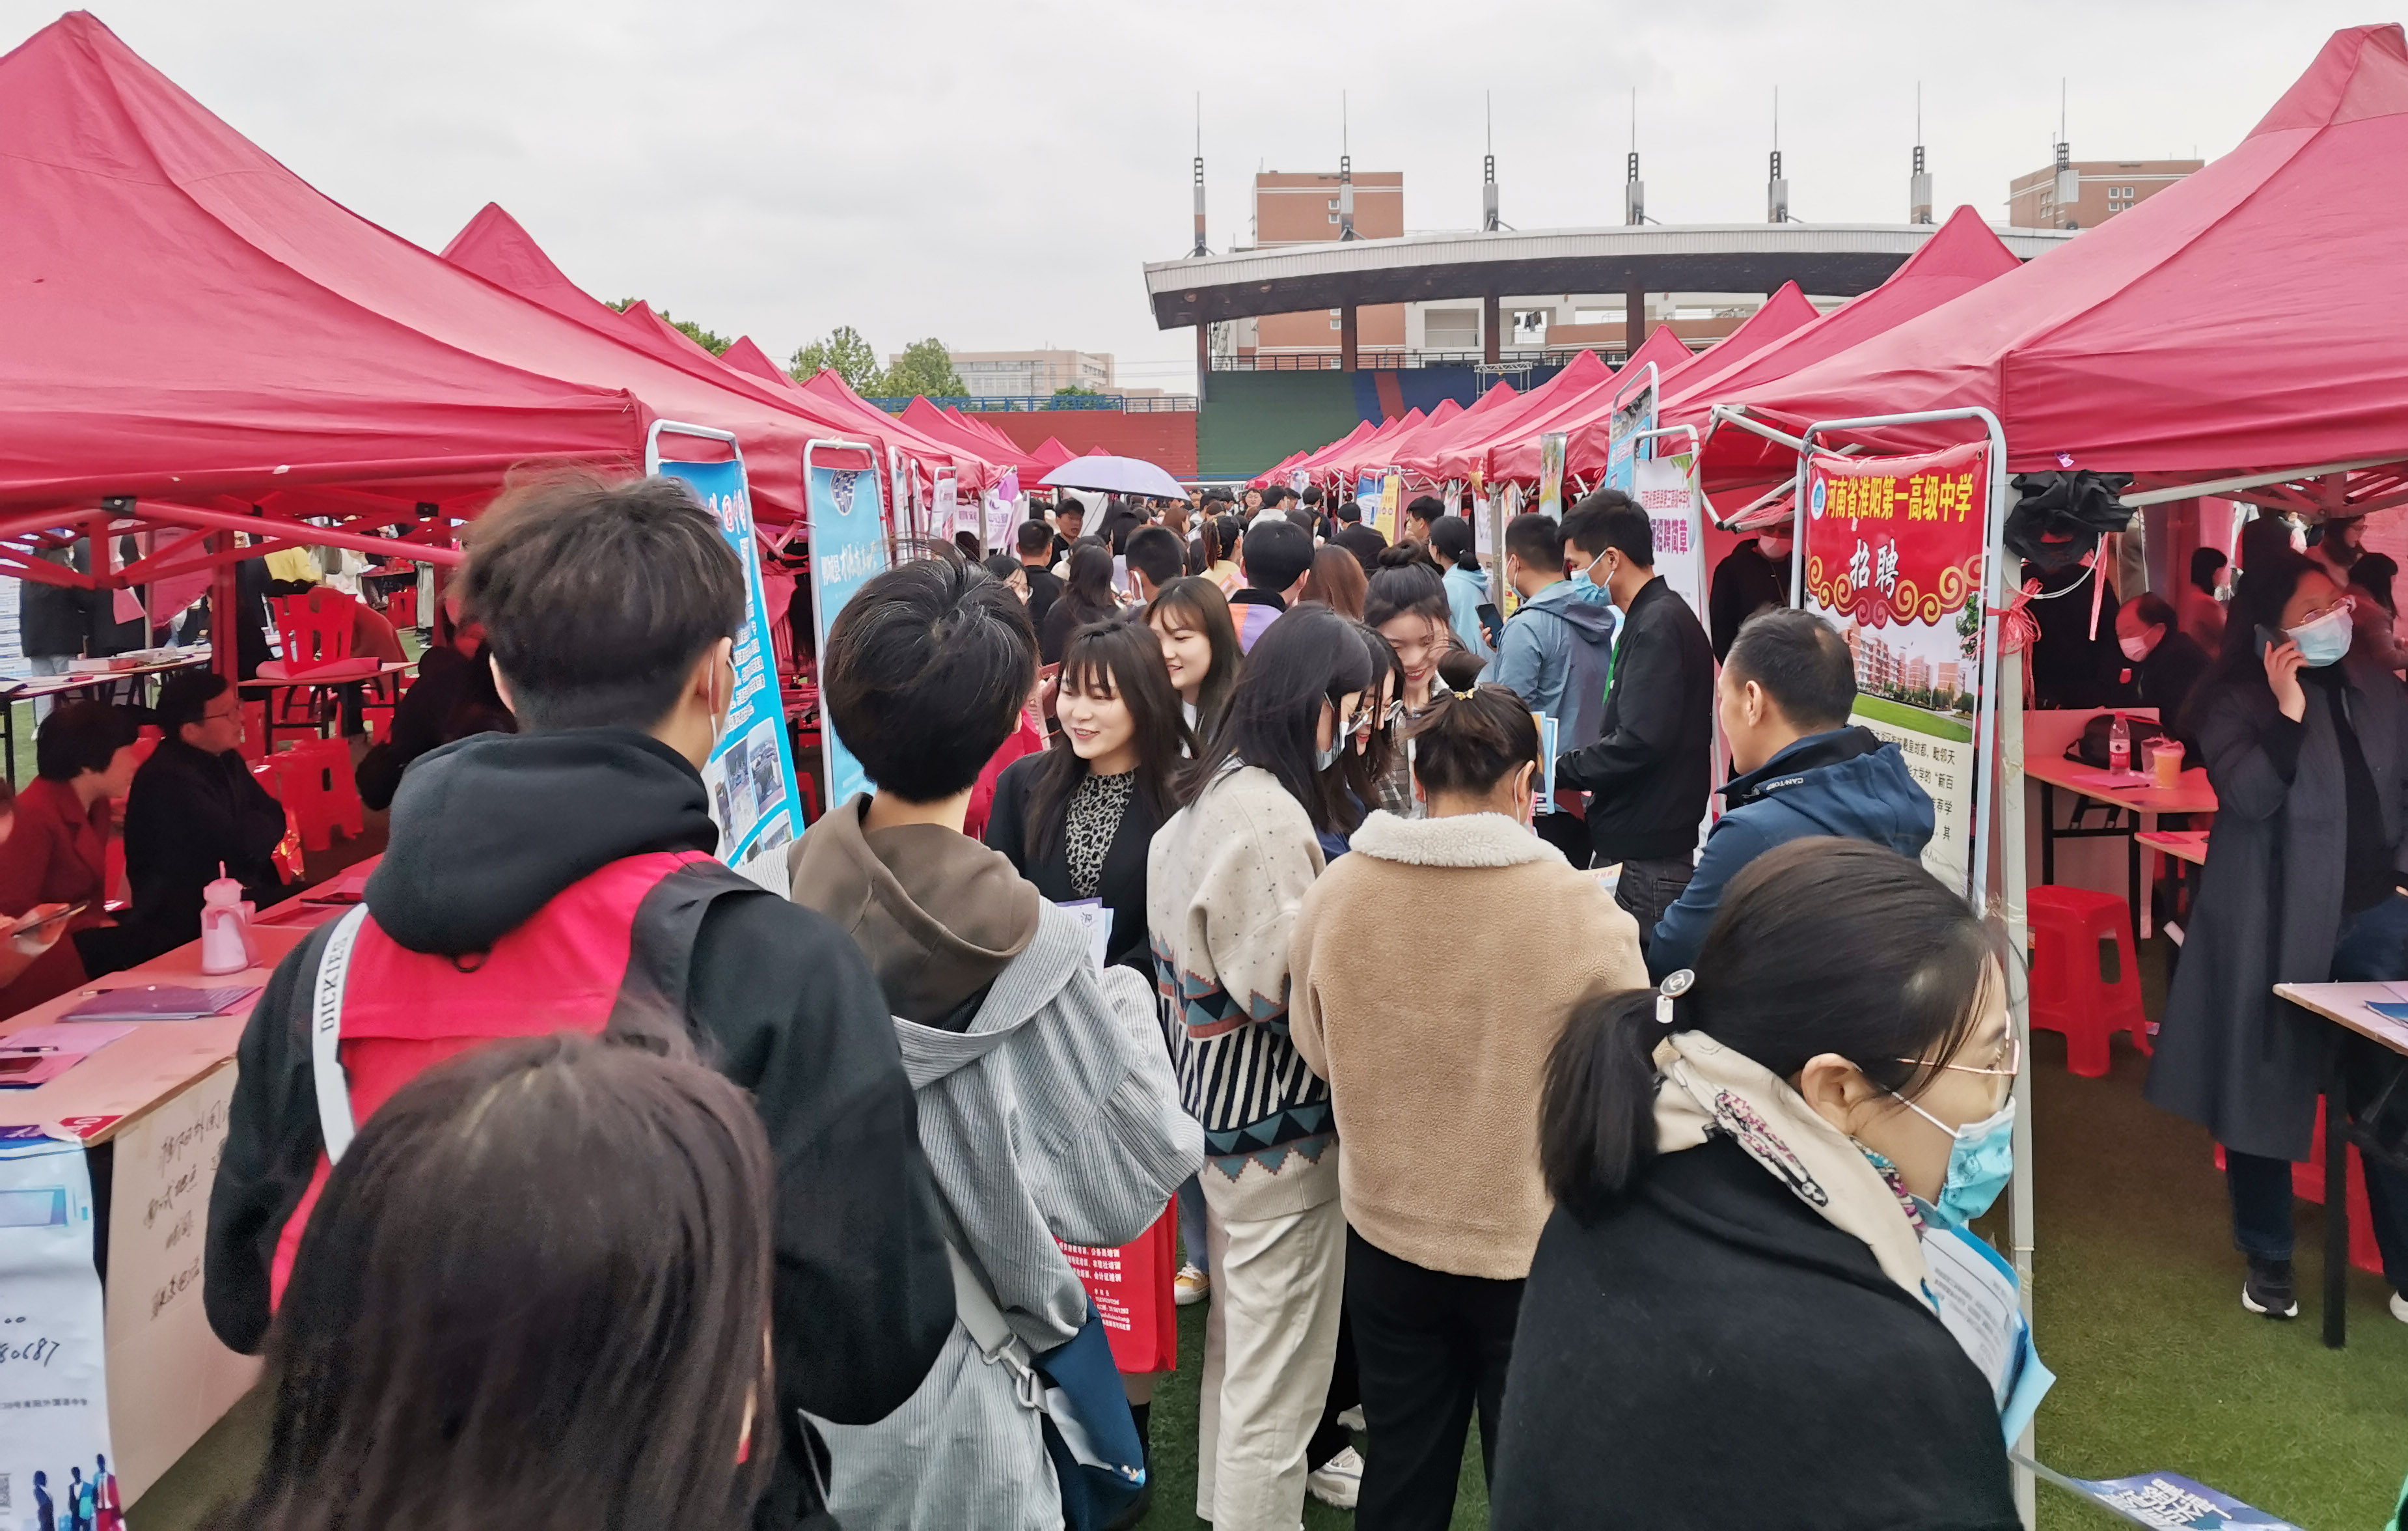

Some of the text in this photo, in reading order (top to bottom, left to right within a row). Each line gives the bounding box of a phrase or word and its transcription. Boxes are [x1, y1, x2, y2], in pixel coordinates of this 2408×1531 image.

[1826, 473, 1973, 523] 河南省淮阳第一高级中学
[1849, 538, 1899, 600] 招聘
[320, 936, 348, 1034] DICKIES
